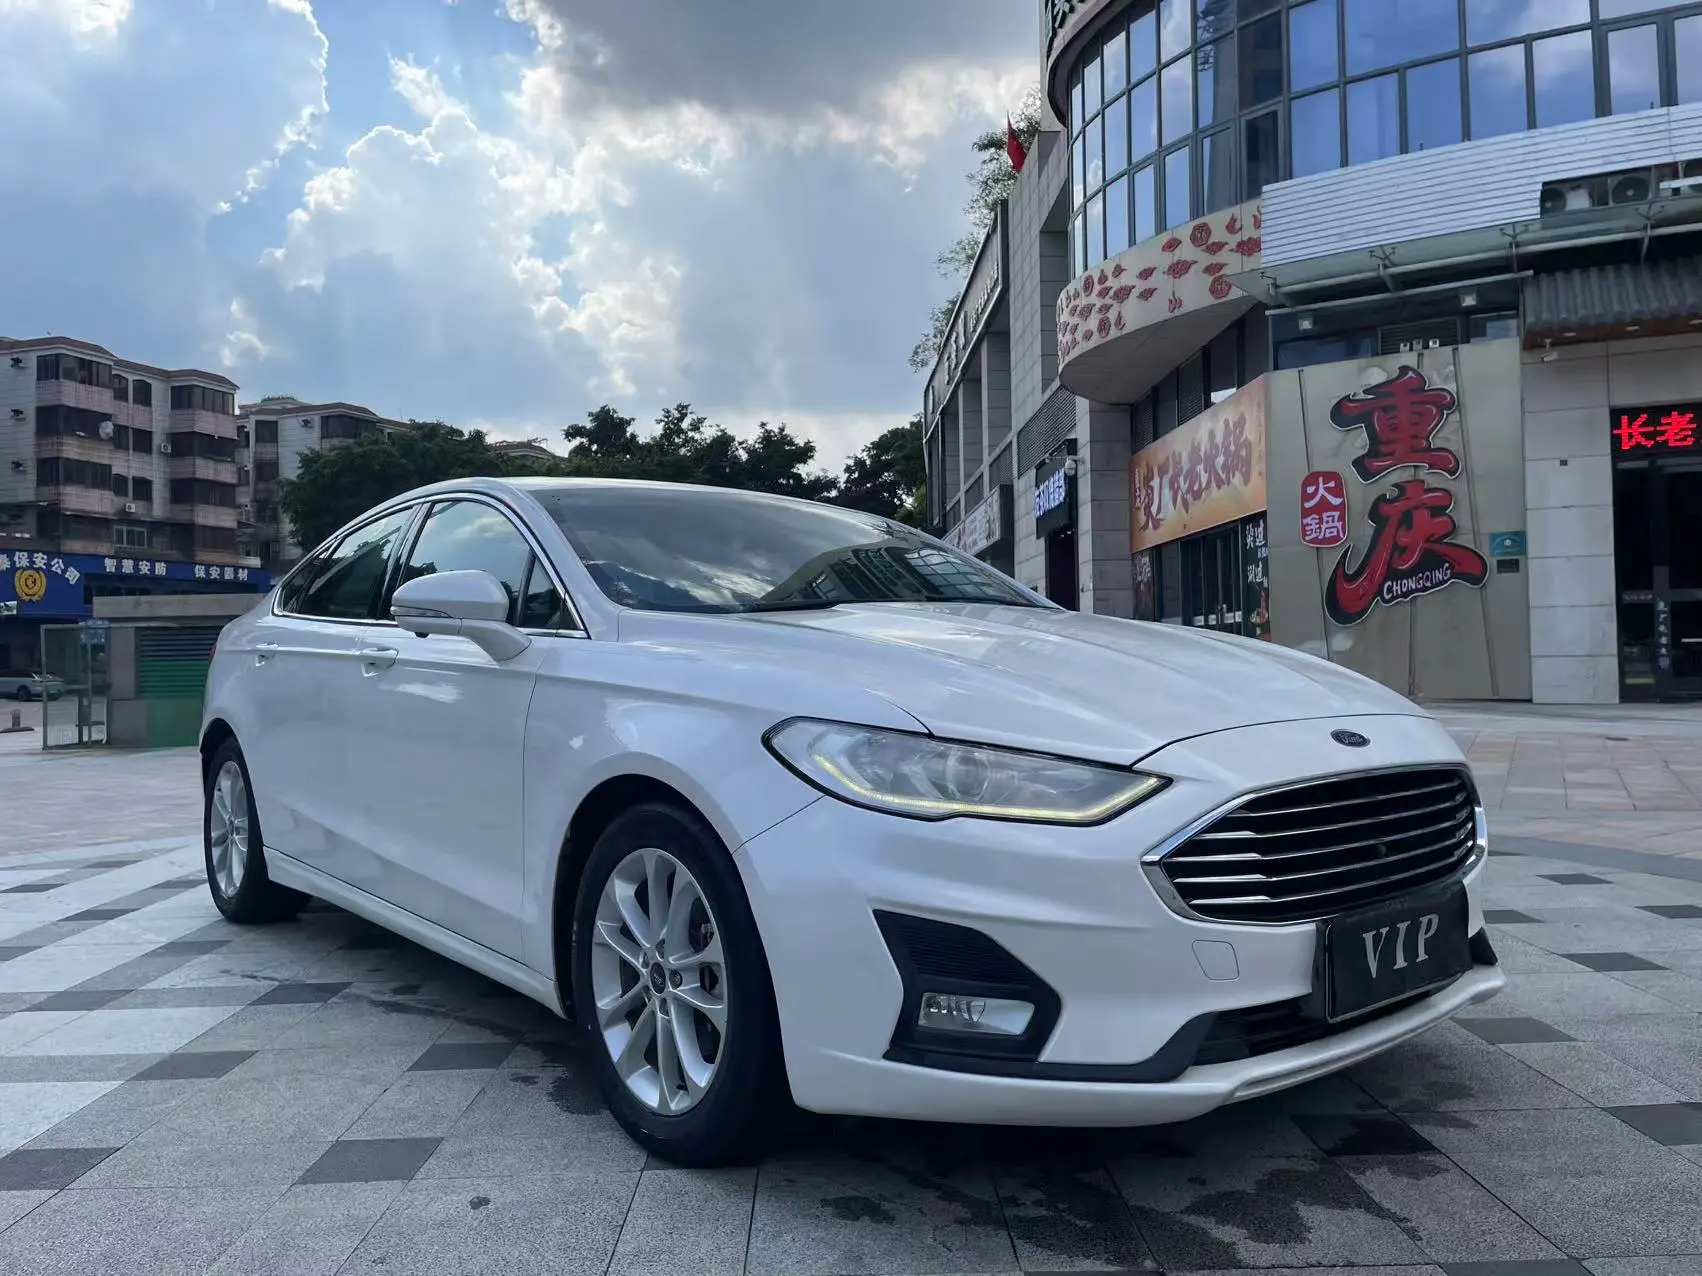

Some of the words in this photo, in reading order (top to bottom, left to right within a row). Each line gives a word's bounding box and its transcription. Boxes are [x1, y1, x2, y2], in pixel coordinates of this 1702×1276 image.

[1613, 411, 1697, 450] 长老
[1330, 365, 1488, 625] 重庆
[104, 557, 168, 576] 智慧安防
[194, 565, 249, 581] 保安器材
[1383, 562, 1451, 600] CHONGQING
[1362, 913, 1439, 978] VIP
